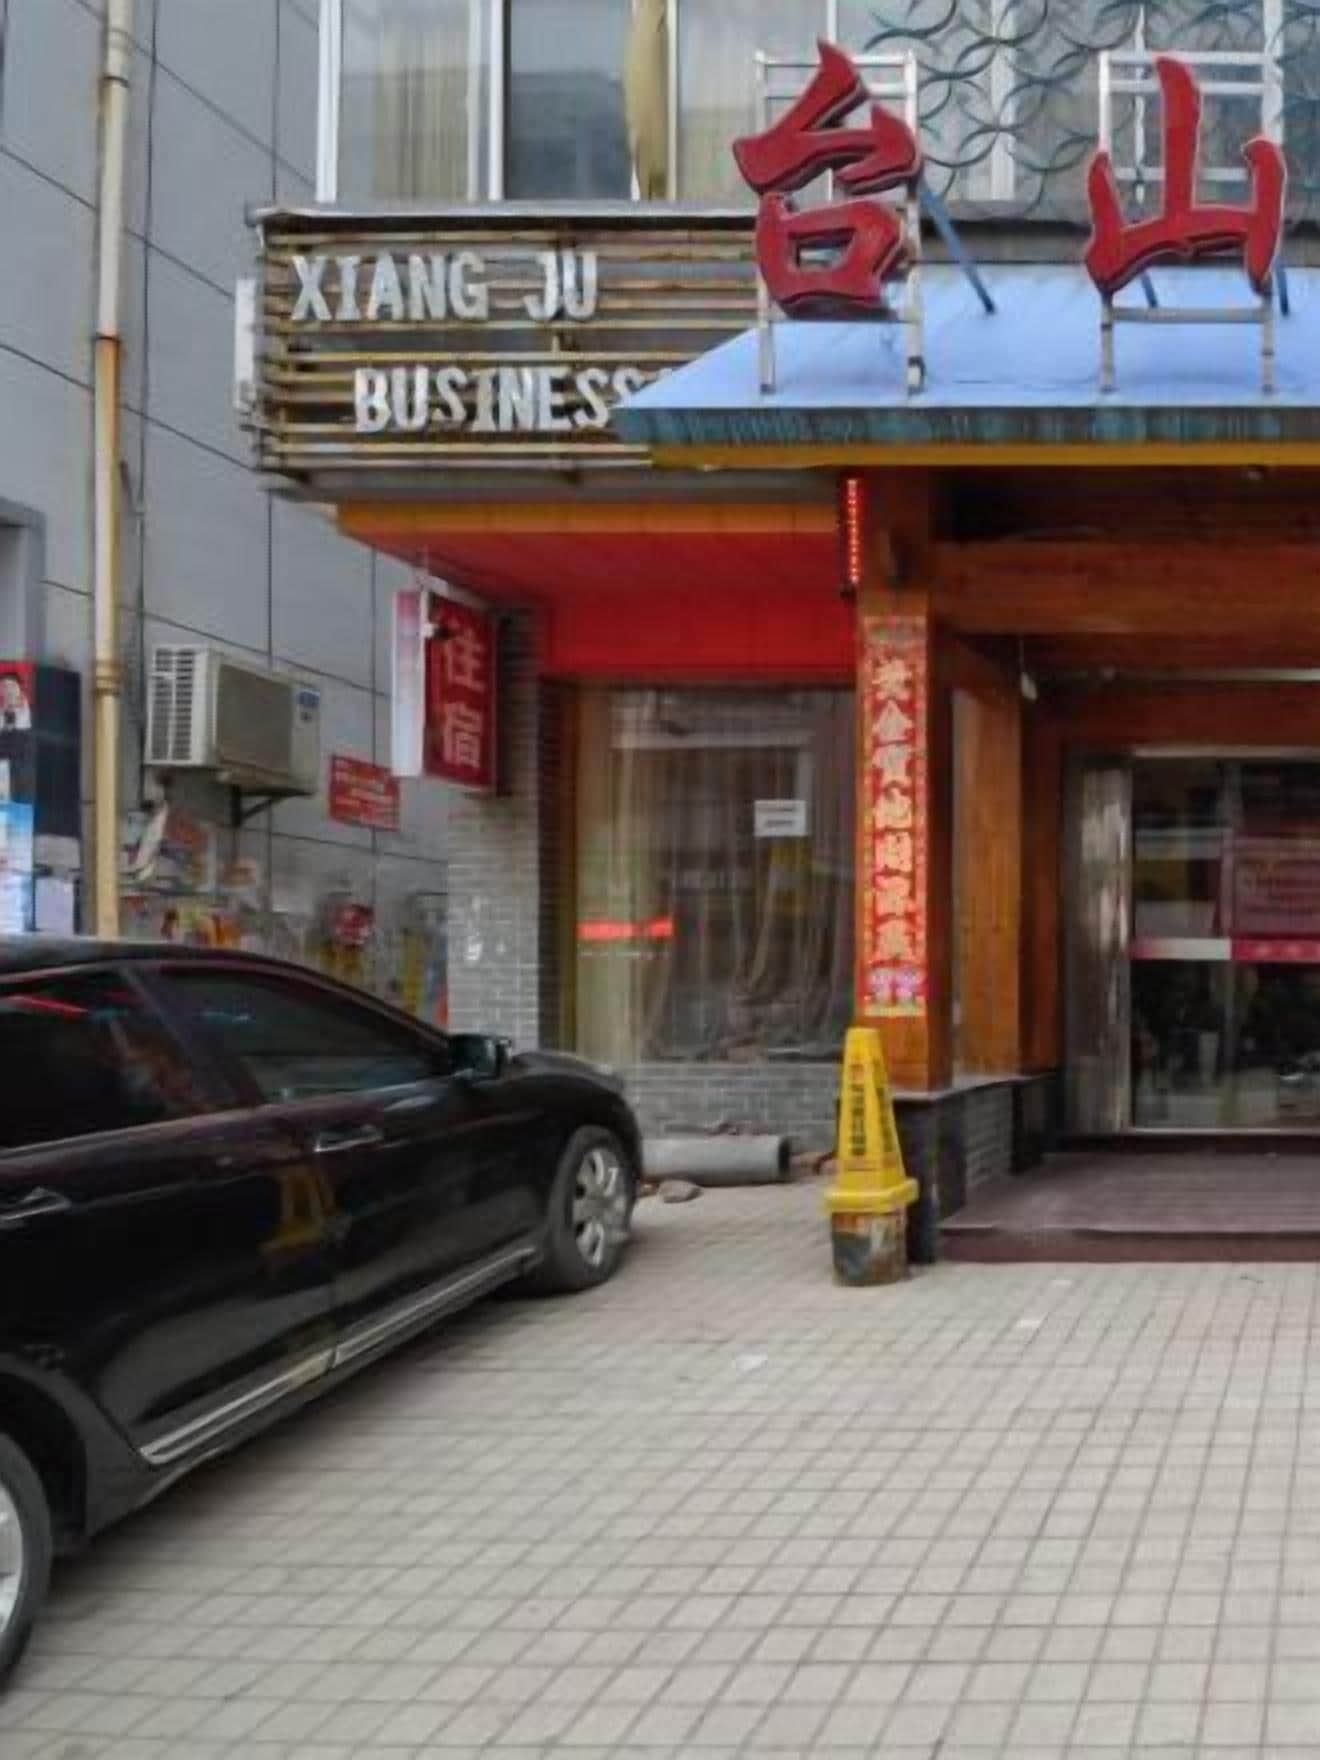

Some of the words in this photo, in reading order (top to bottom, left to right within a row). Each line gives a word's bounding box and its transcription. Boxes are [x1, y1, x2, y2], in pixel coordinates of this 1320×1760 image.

[292, 251, 488, 321] XIANG
[524, 250, 597, 321] JU
[442, 617, 487, 769] 住宿
